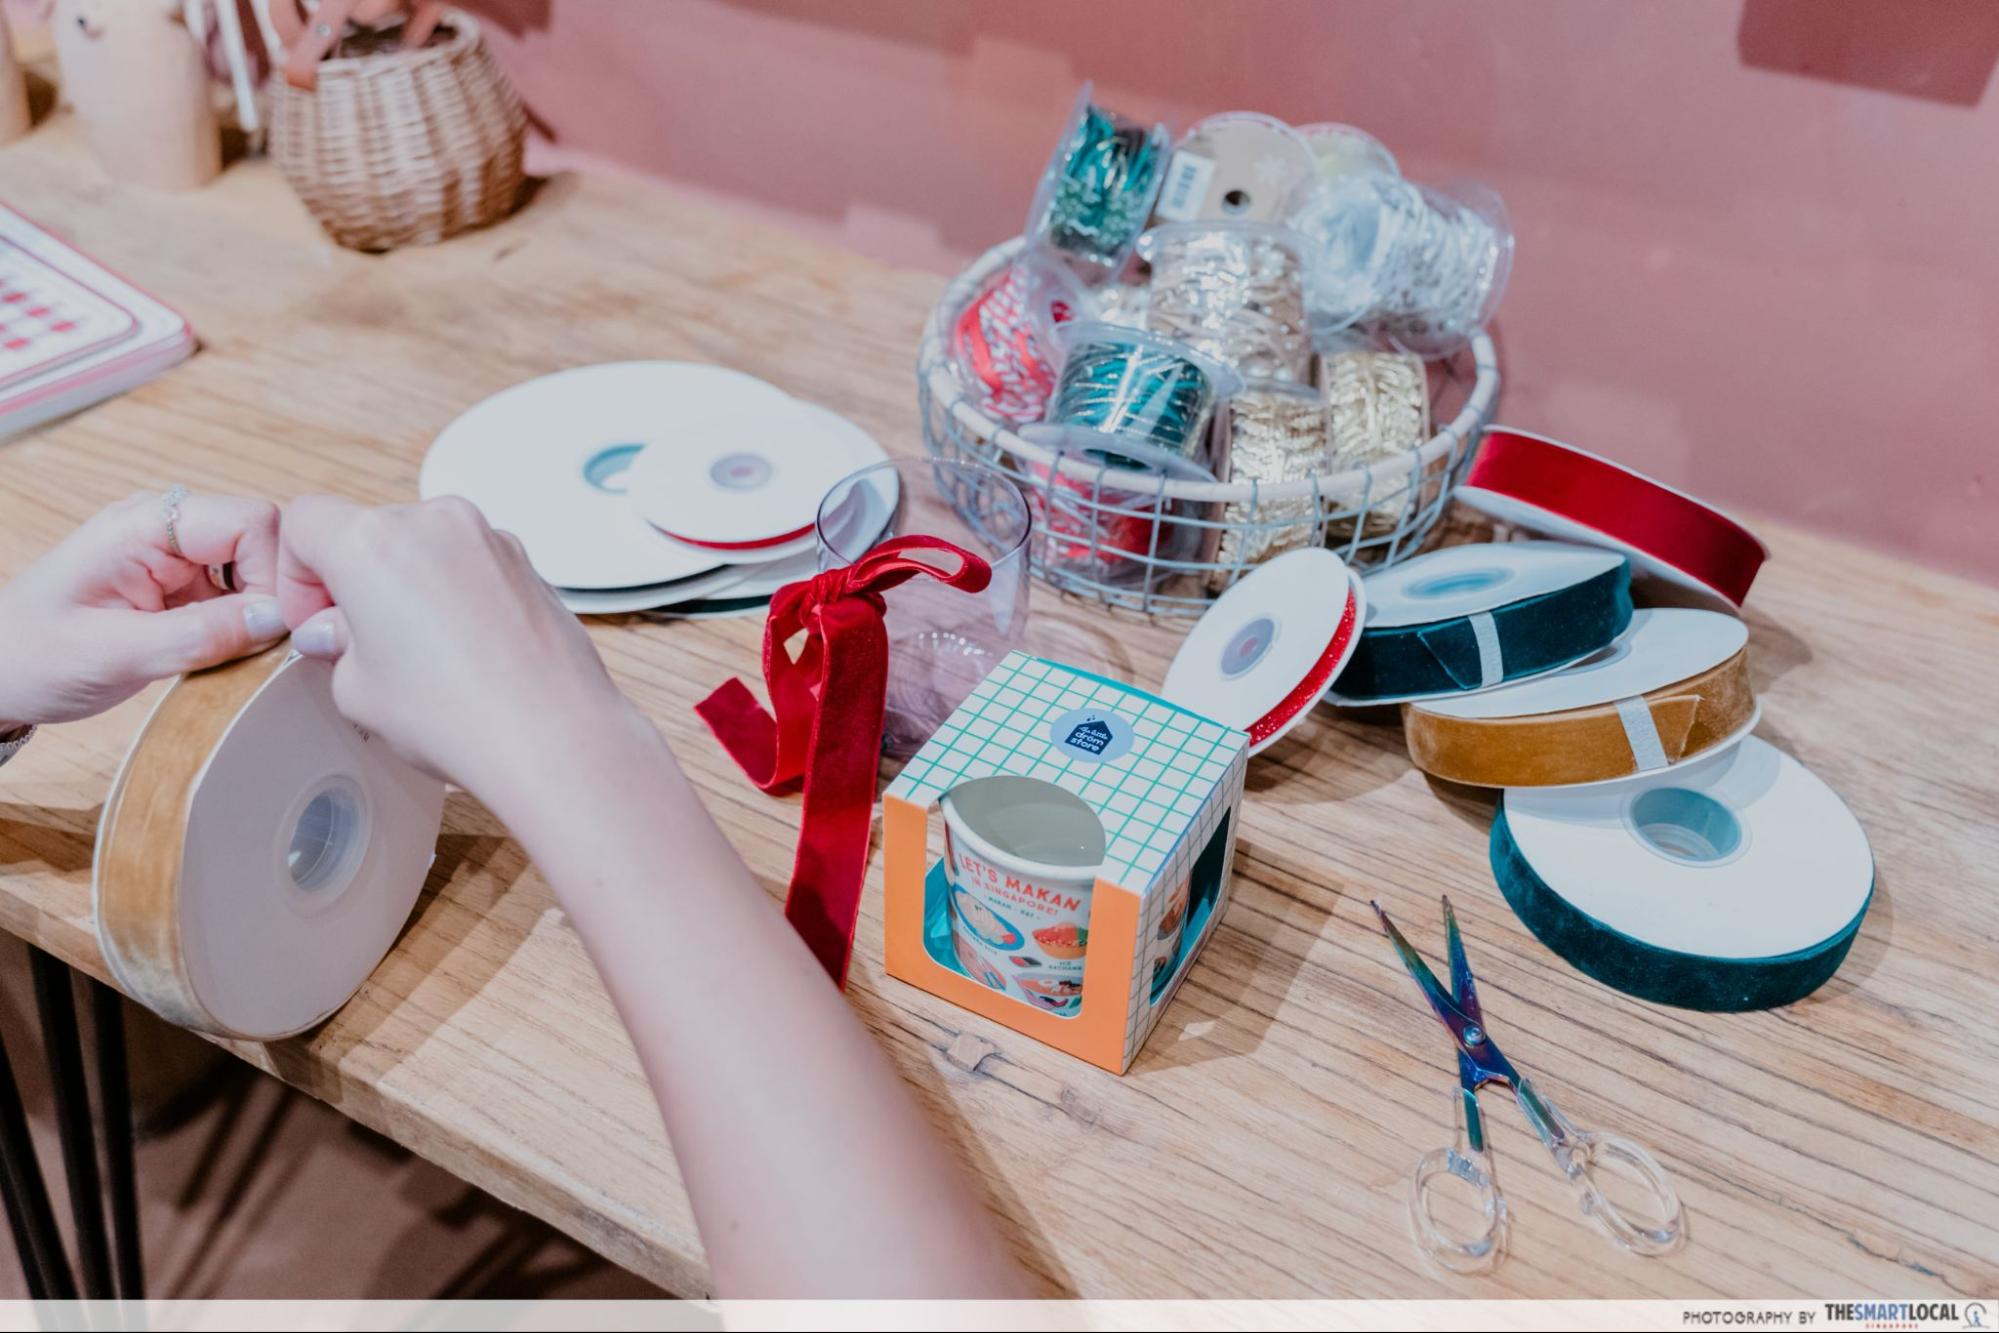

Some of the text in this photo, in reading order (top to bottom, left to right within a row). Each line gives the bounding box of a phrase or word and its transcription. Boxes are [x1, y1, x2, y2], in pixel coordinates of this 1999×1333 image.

[1070, 738, 1100, 751] store
[960, 853, 1081, 912] LET'S MAKAN
